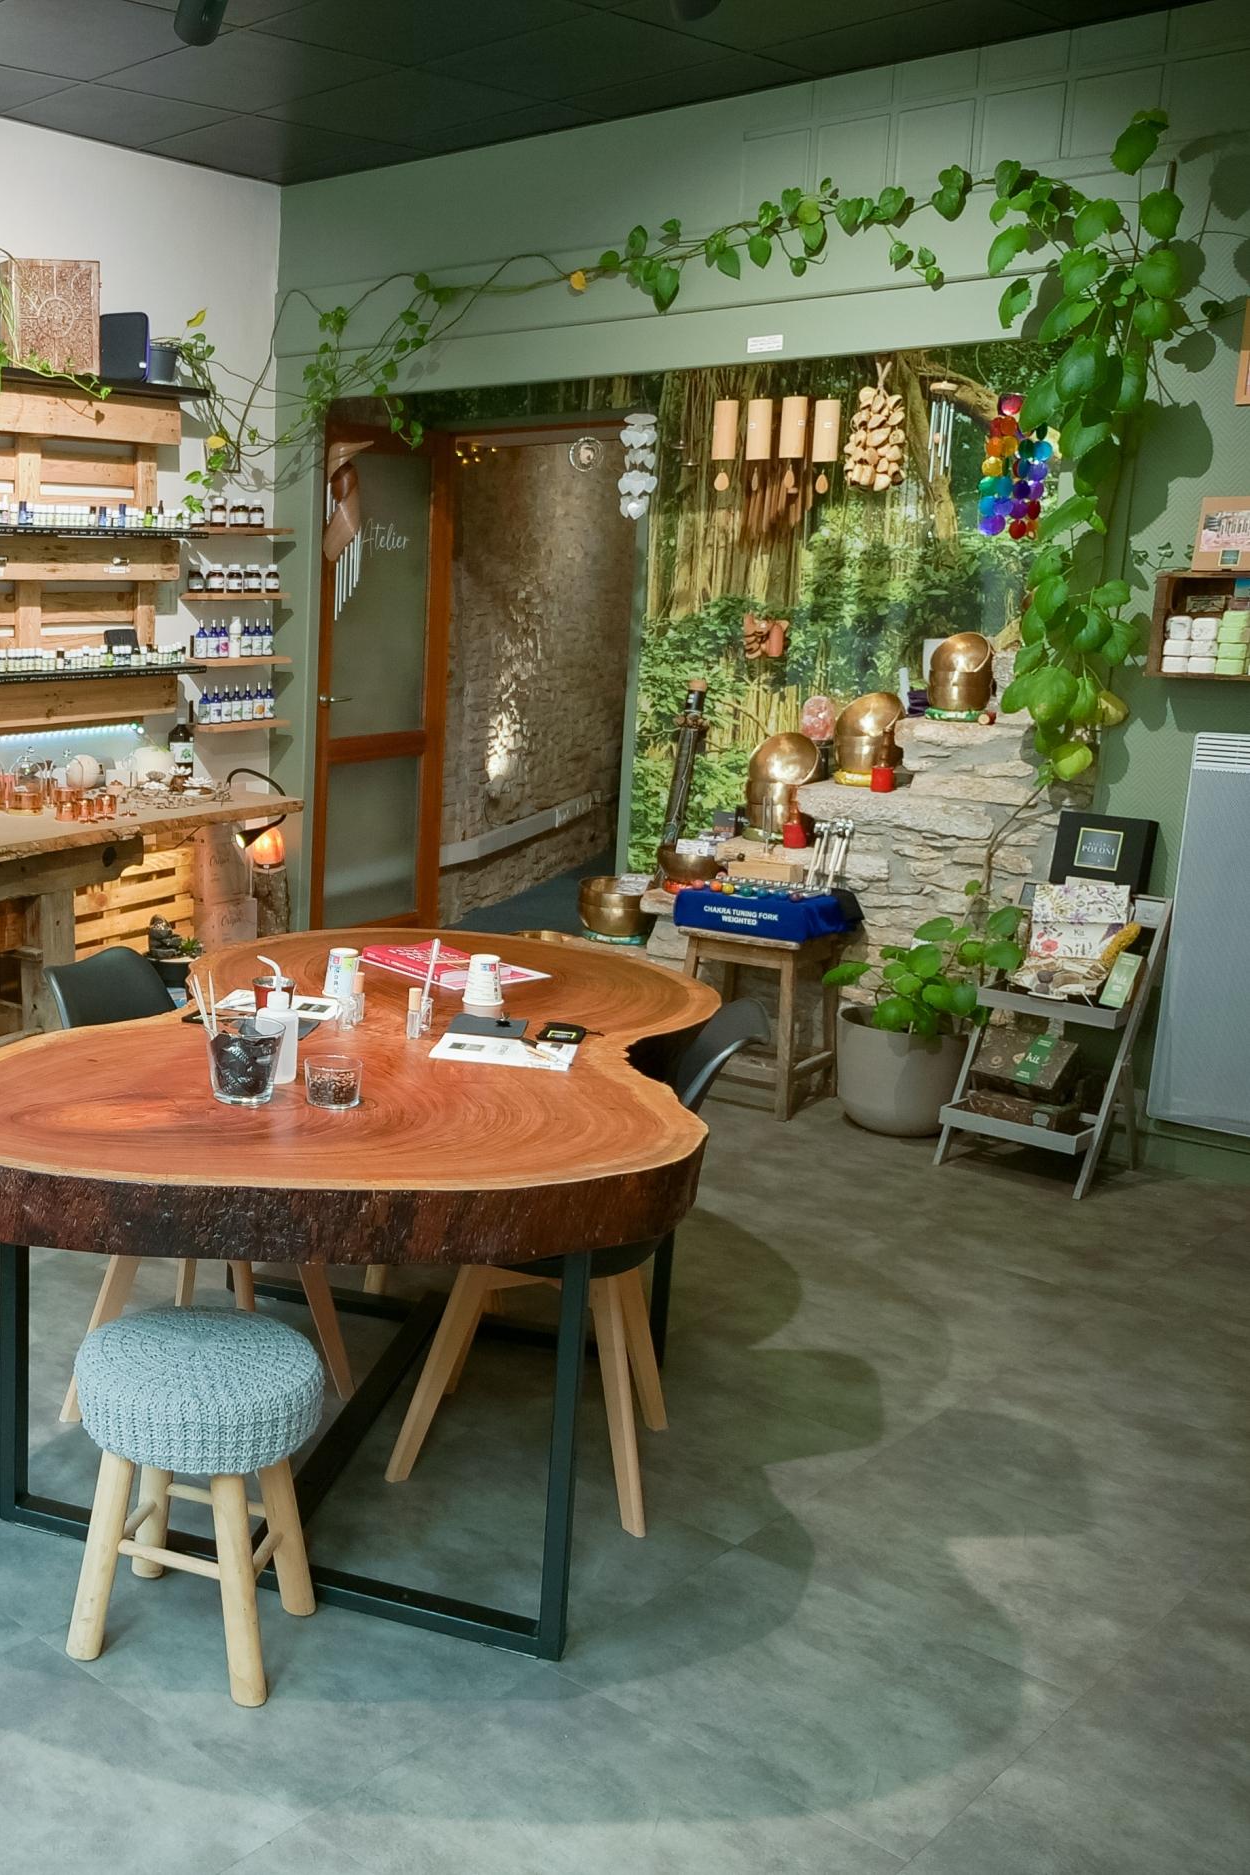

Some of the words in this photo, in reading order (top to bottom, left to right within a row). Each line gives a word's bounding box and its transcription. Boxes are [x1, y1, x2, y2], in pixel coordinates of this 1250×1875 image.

[359, 518, 411, 558] Atelier
[1082, 845, 1115, 856] POLONI
[703, 905, 731, 915] CHAKRA
[732, 908, 757, 918] TUNING
[758, 912, 779, 921] FORK
[721, 915, 758, 926] WEIGHTED
